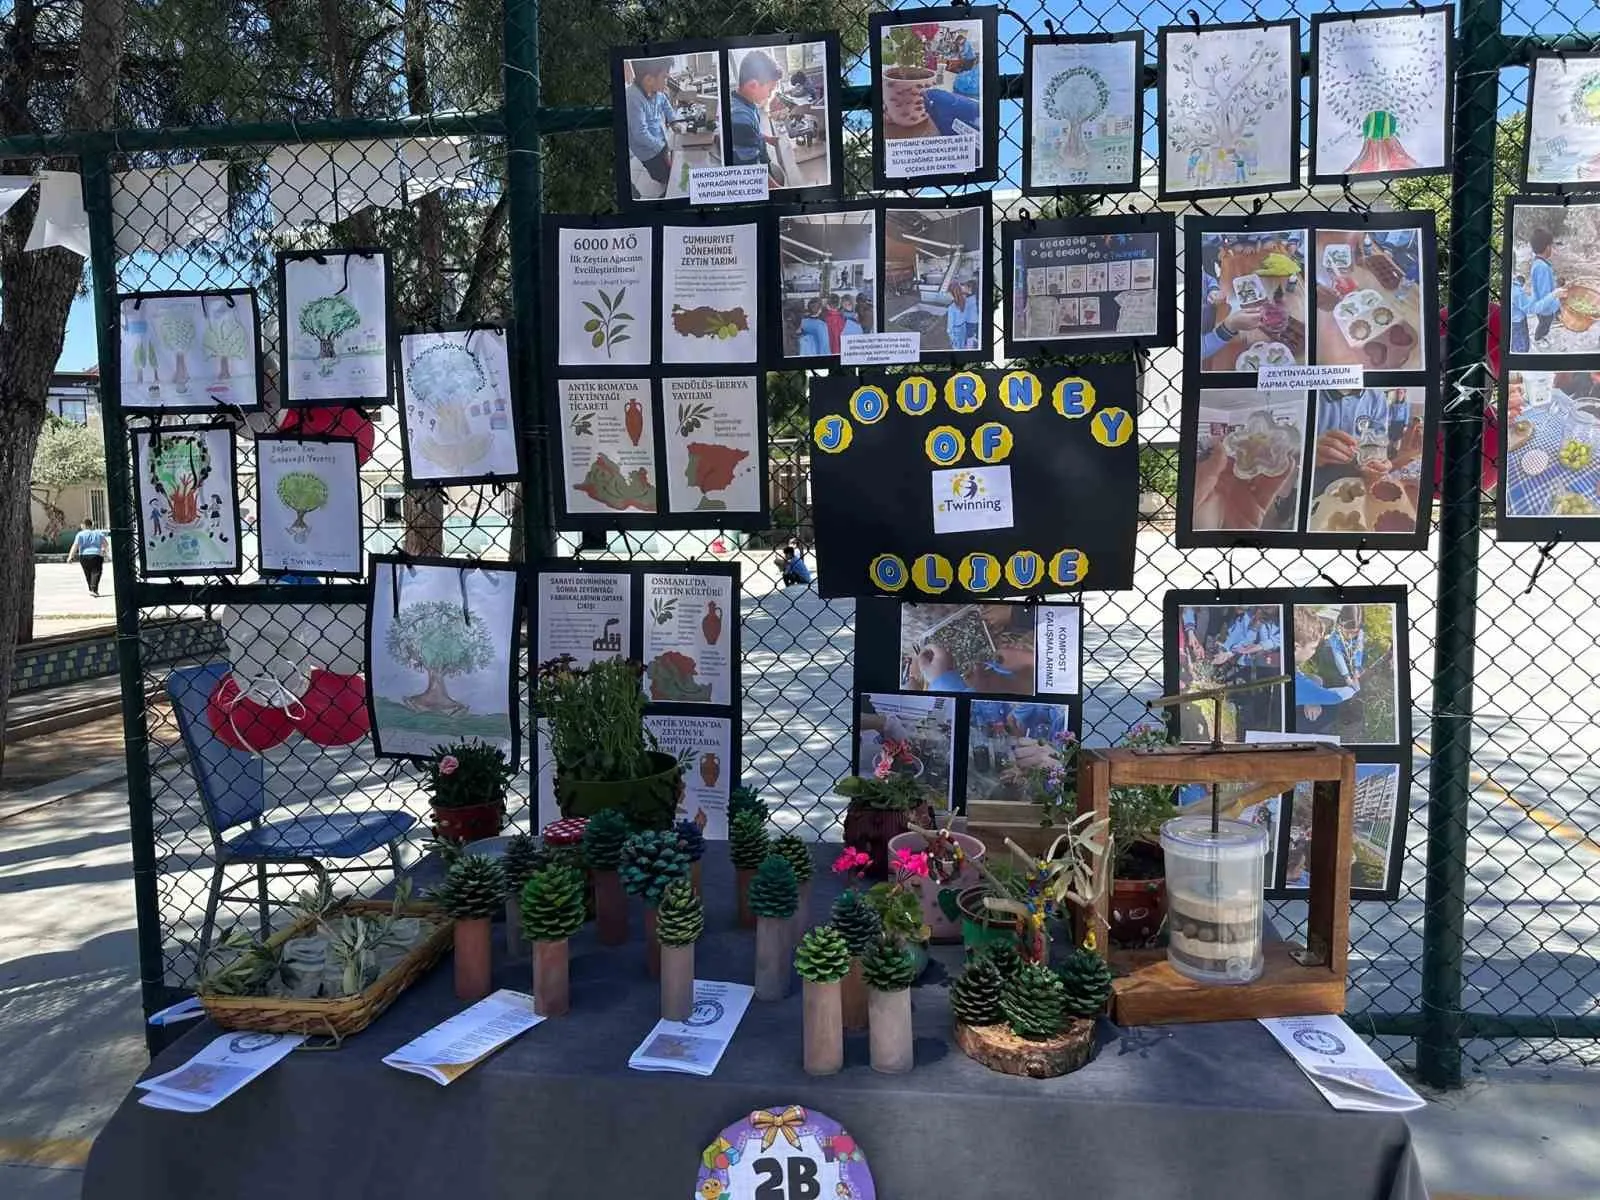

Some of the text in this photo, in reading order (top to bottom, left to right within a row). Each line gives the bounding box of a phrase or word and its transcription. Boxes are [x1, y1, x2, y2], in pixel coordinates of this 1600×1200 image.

[574, 233, 638, 250] 6000 MÖ
[683, 234, 736, 244] CUMHURİYET
[686, 245, 732, 255] DÖNEMİNDE
[583, 255, 608, 264] Zeytin
[681, 256, 737, 265] ZEYTİN TARIMI
[1321, 367, 1350, 375] SABUN
[568, 382, 596, 391] ANTİK
[1259, 380, 1288, 389] YAPMA
[672, 391, 712, 400] YAYILIMI
[820, 376, 1125, 448] JOURNEY
[933, 426, 1002, 461] OF
[877, 552, 1080, 590] OLIVE
[651, 586, 723, 596] ZEYTİN KÜLTÜRÜ
[1058, 626, 1067, 672] KOMPOST
[752, 1157, 820, 1200] 2B
